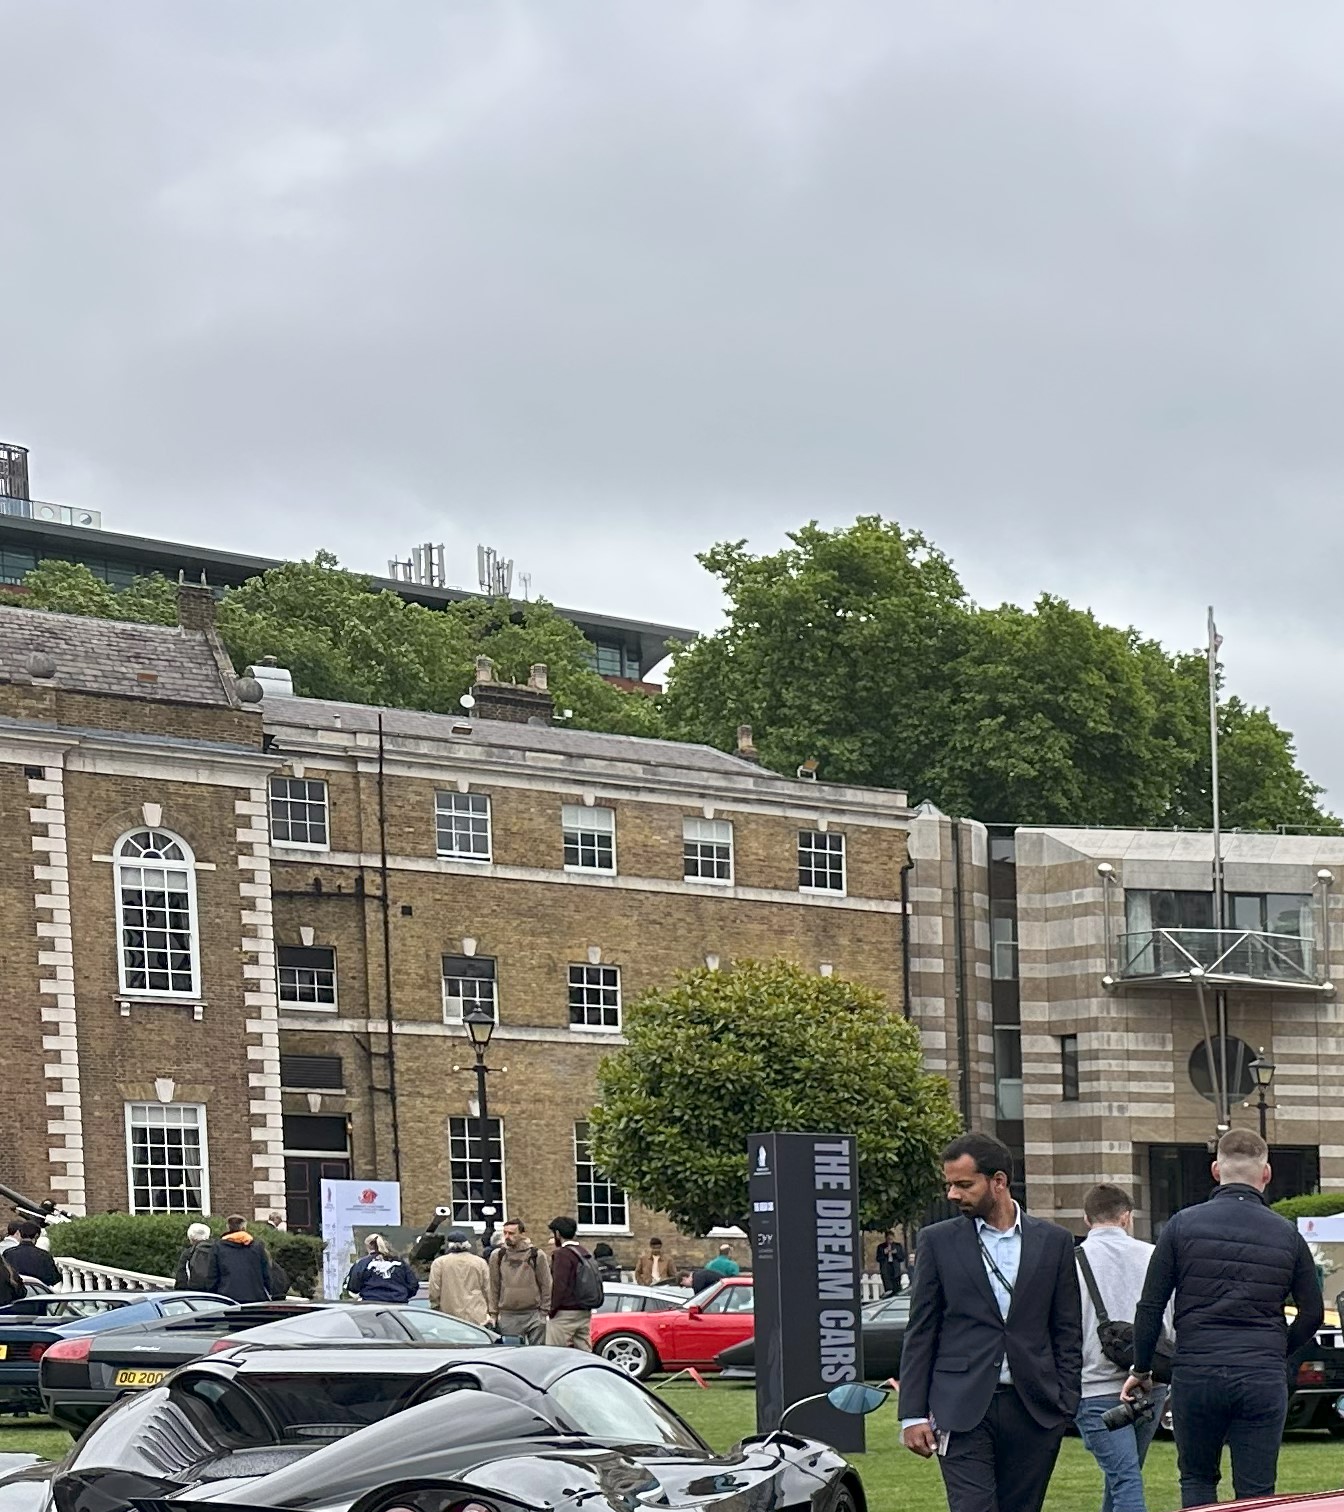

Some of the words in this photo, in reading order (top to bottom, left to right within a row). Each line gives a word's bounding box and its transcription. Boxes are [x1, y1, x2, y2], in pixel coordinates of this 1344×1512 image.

[814, 1140, 850, 1190] THE
[816, 1200, 854, 1300] DREAM
[819, 1309, 857, 1383] CARS
